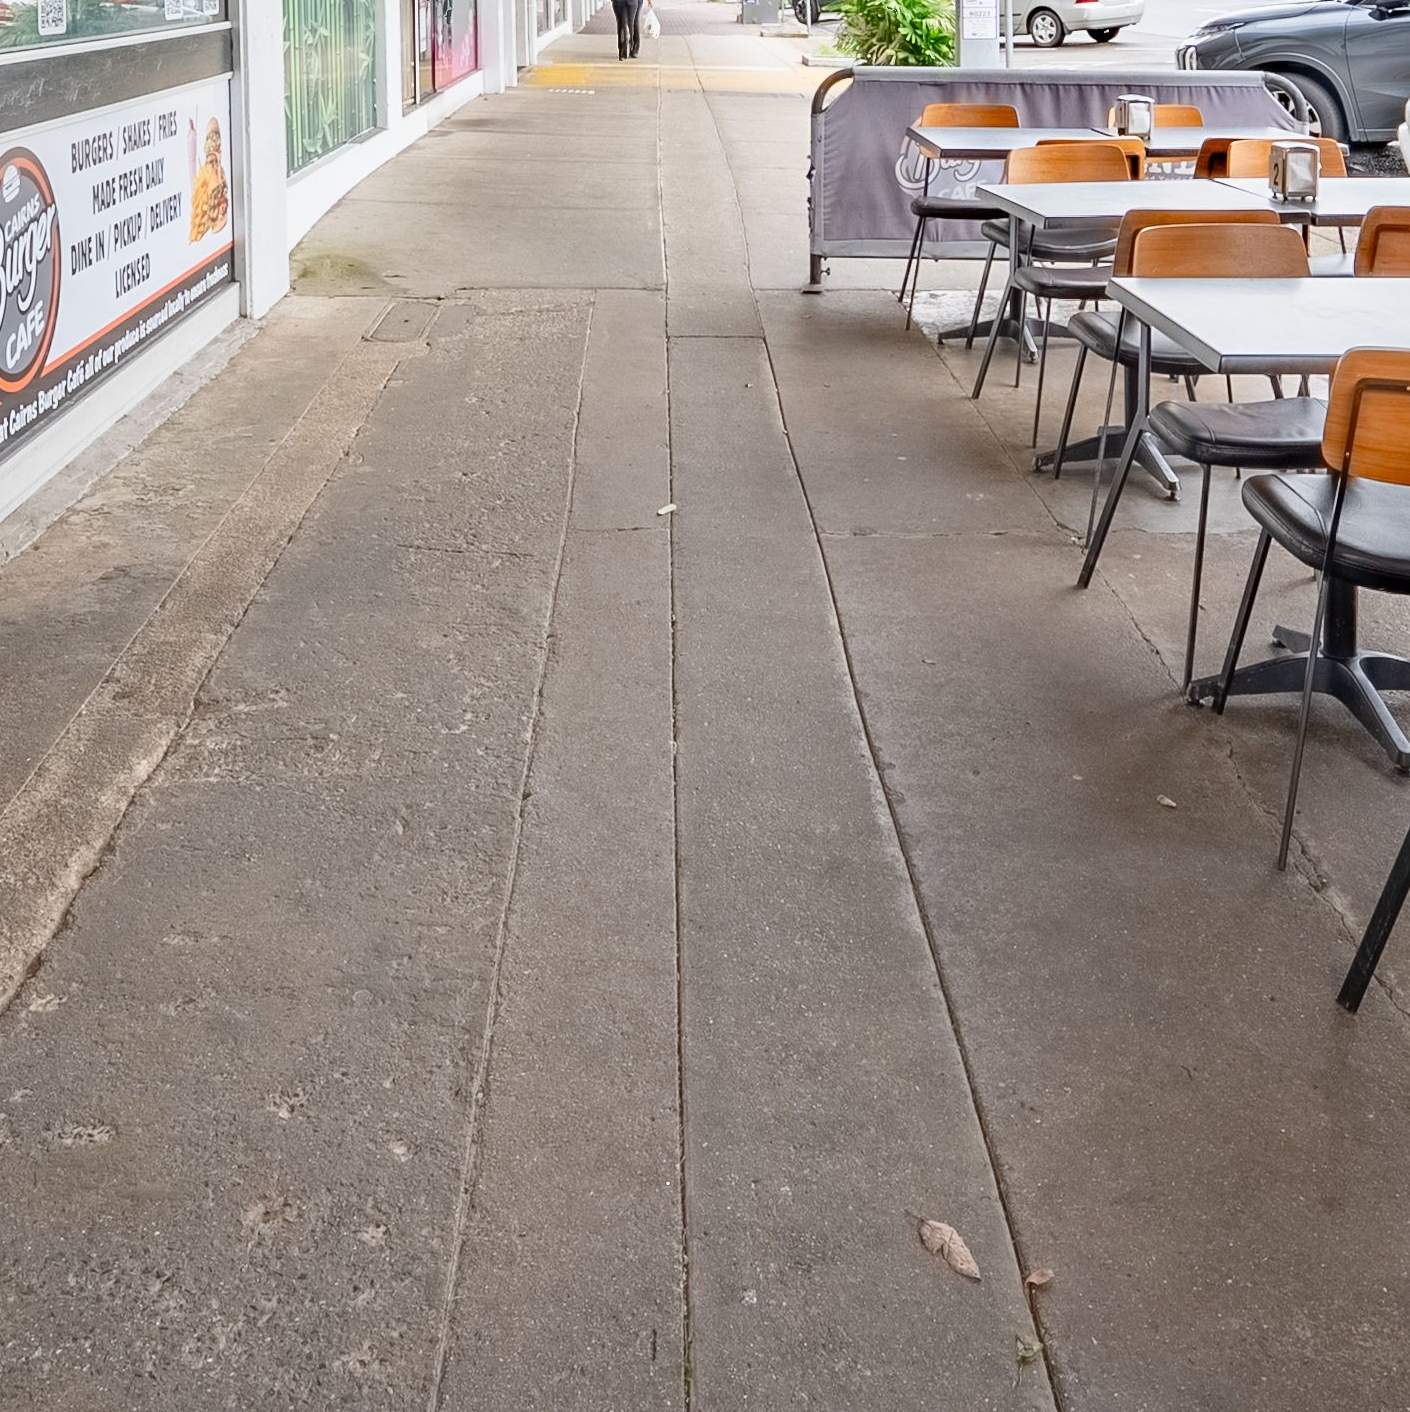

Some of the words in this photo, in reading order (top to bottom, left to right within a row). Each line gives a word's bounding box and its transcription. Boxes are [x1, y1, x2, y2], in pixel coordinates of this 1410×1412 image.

[71, 131, 114, 174] BURGERS
[122, 118, 151, 155] SHAKES
[158, 110, 178, 141] FRIES
[92, 177, 116, 215] MADE
[118, 165, 144, 203] FRESH
[145, 157, 165, 191] DAILY
[1273, 162, 1280, 186] 2
[4, 193, 41, 242] CAIRNS
[70, 236, 93, 276] DINE
[95, 229, 106, 263] IN
[114, 211, 142, 253] PICKUP
[150, 191, 183, 233] DELIVERY
[114, 252, 151, 299] LICENSED
[5, 299, 46, 369] CAFE
[9, 404, 38, 435] Cairns
[38, 379, 67, 414] Burger
[85, 354, 95, 381] all
[102, 345, 115, 367] our
[114, 327, 140, 364] produce
[139, 320, 146, 340] is
[146, 301, 168, 334] sourced
